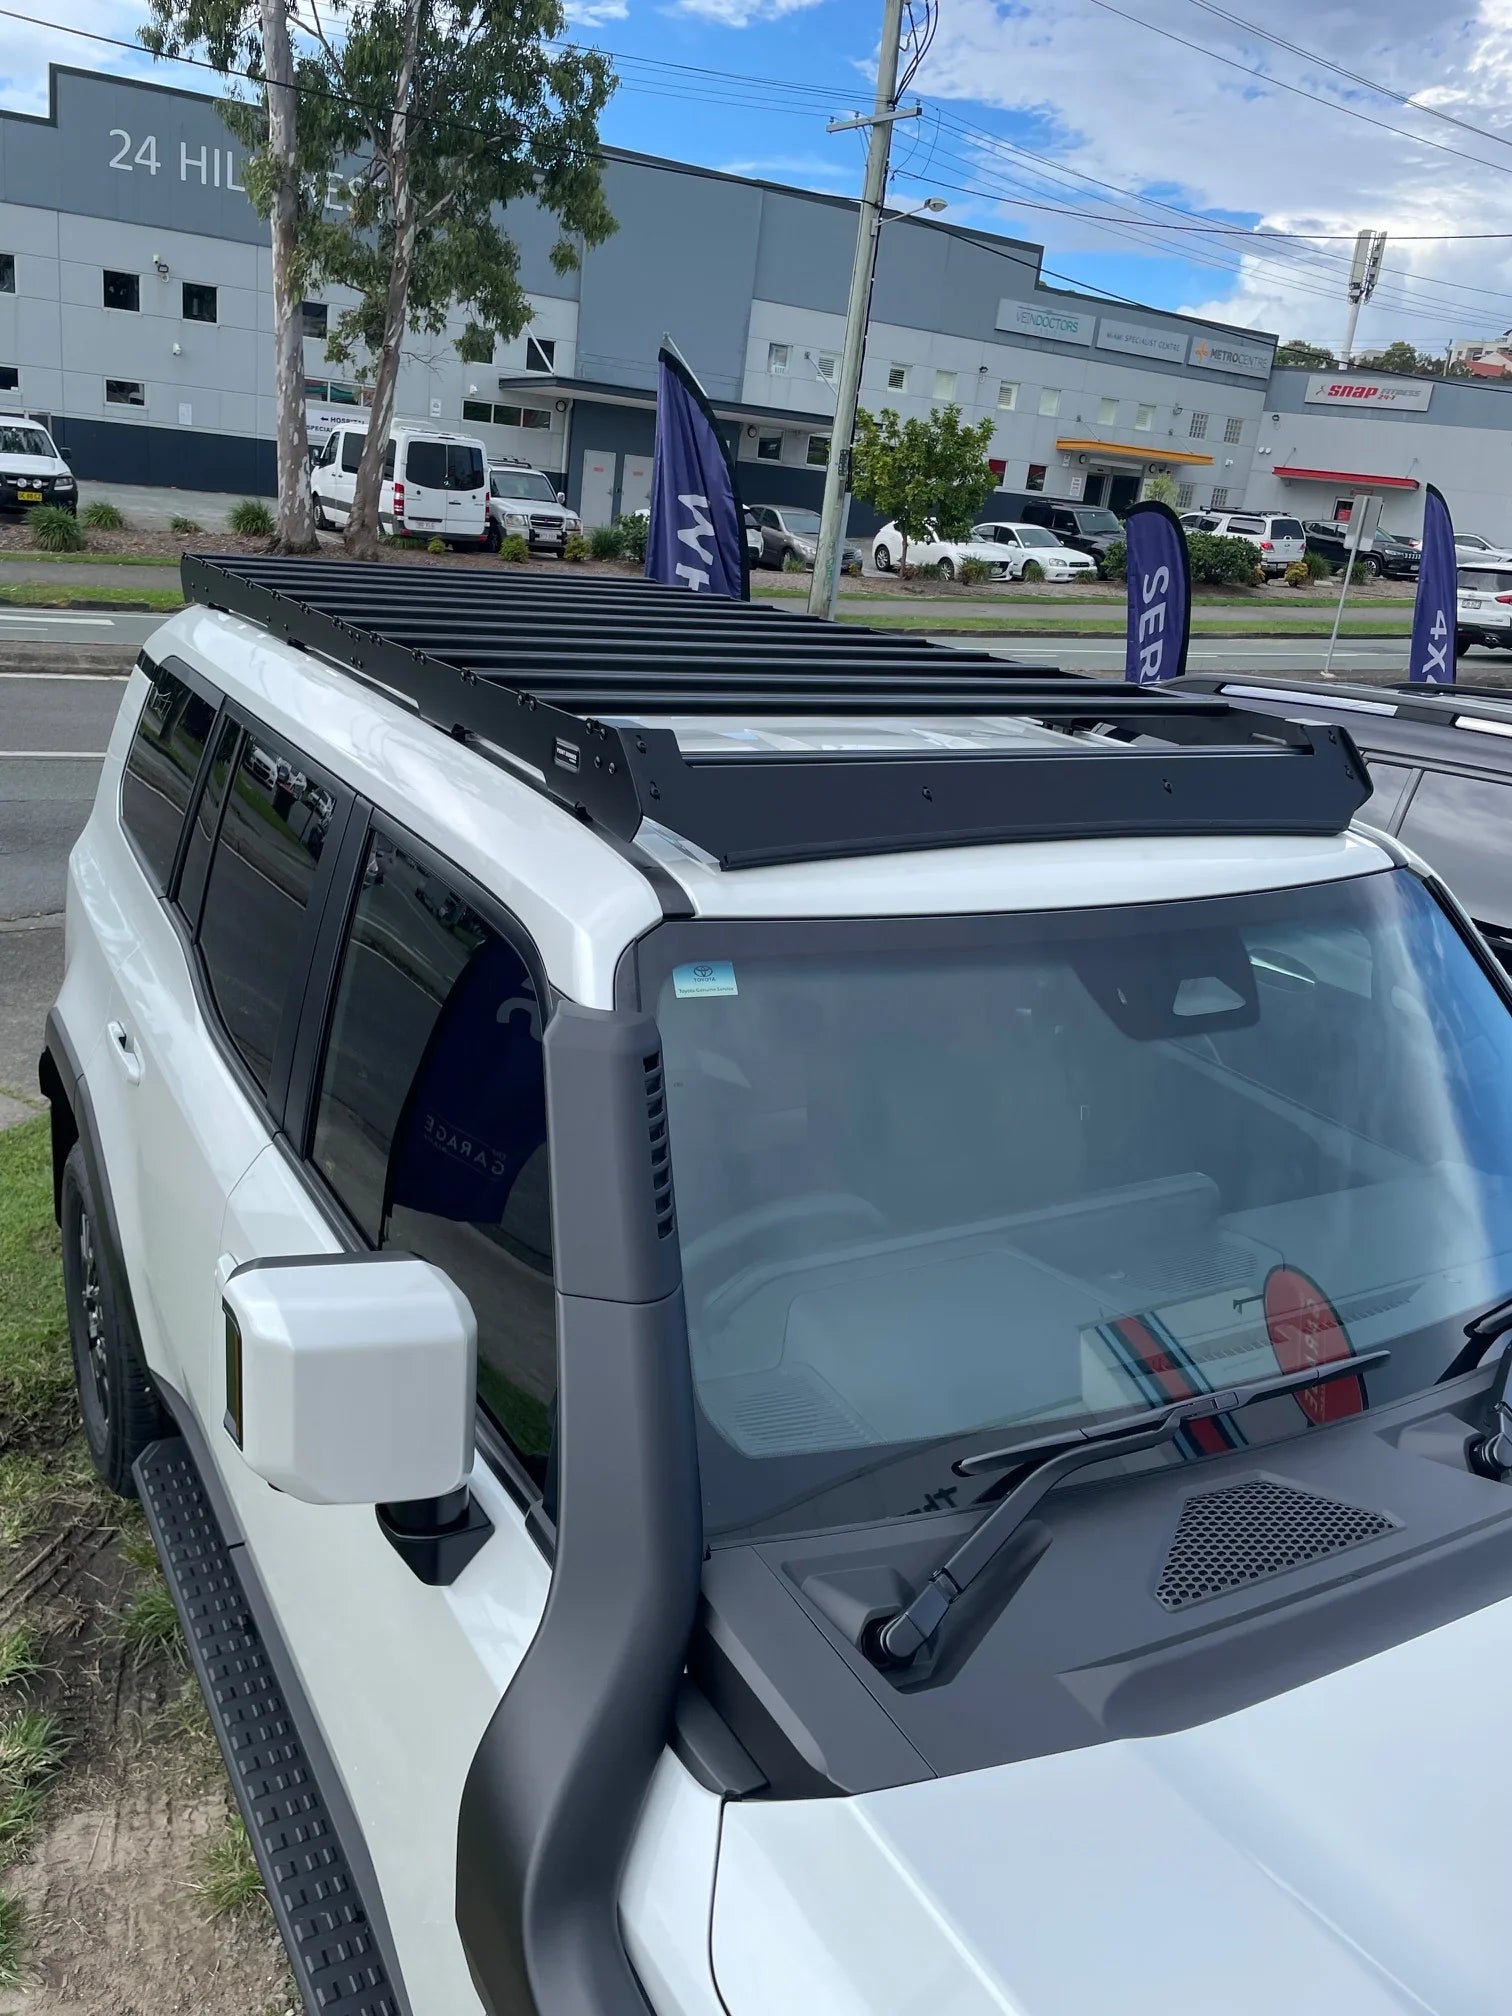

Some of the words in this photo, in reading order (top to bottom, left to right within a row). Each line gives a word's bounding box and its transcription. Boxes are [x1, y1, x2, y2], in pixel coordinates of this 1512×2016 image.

[109, 128, 162, 176] 24
[1139, 566, 1170, 685] SER
[1421, 609, 1447, 684] 4X
